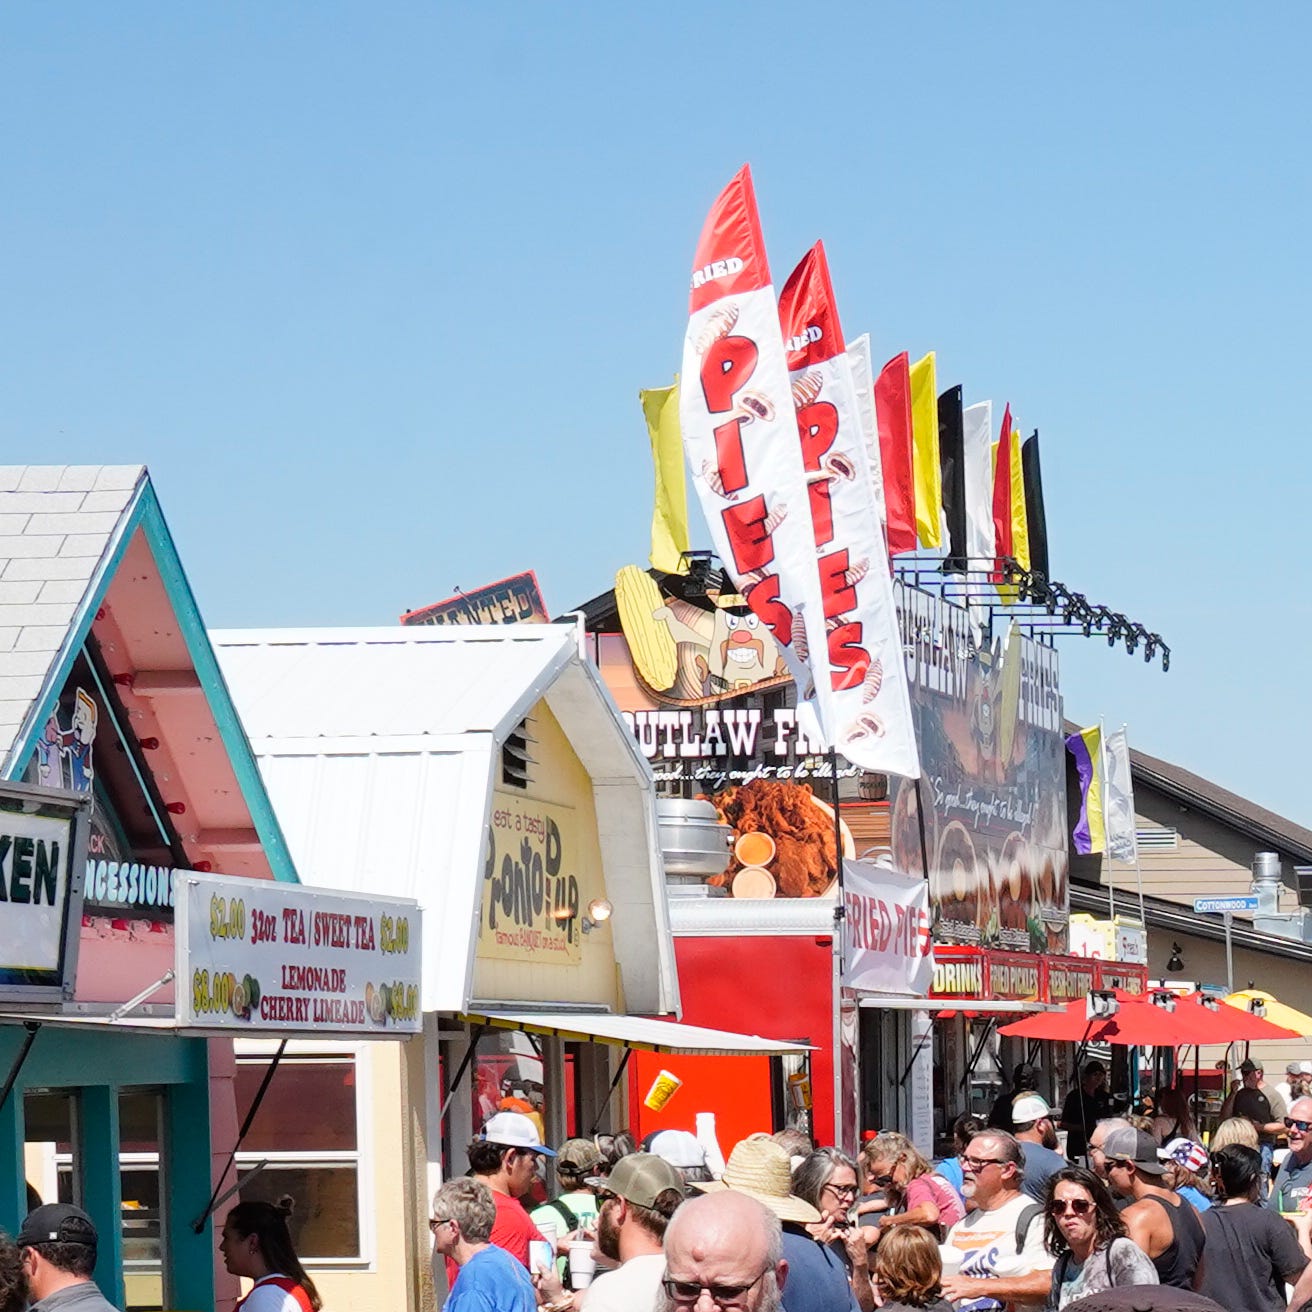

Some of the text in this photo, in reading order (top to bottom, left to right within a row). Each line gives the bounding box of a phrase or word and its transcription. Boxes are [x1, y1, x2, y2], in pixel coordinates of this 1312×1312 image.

[690, 257, 744, 289] RIED
[699, 334, 793, 648] PIES
[800, 401, 873, 693] PIES
[494, 809, 545, 844] eat a tasty
[210, 891, 245, 942] $2.00
[251, 908, 277, 945] 32oz
[283, 908, 306, 945] TEA
[314, 911, 351, 948] SWEET
[354, 916, 376, 951] TEA
[846, 891, 893, 952] FRIED
[281, 964, 347, 993] LEMONADE
[933, 963, 982, 993] DRINKS
[261, 995, 365, 1024] CHERRY LIMEADE
